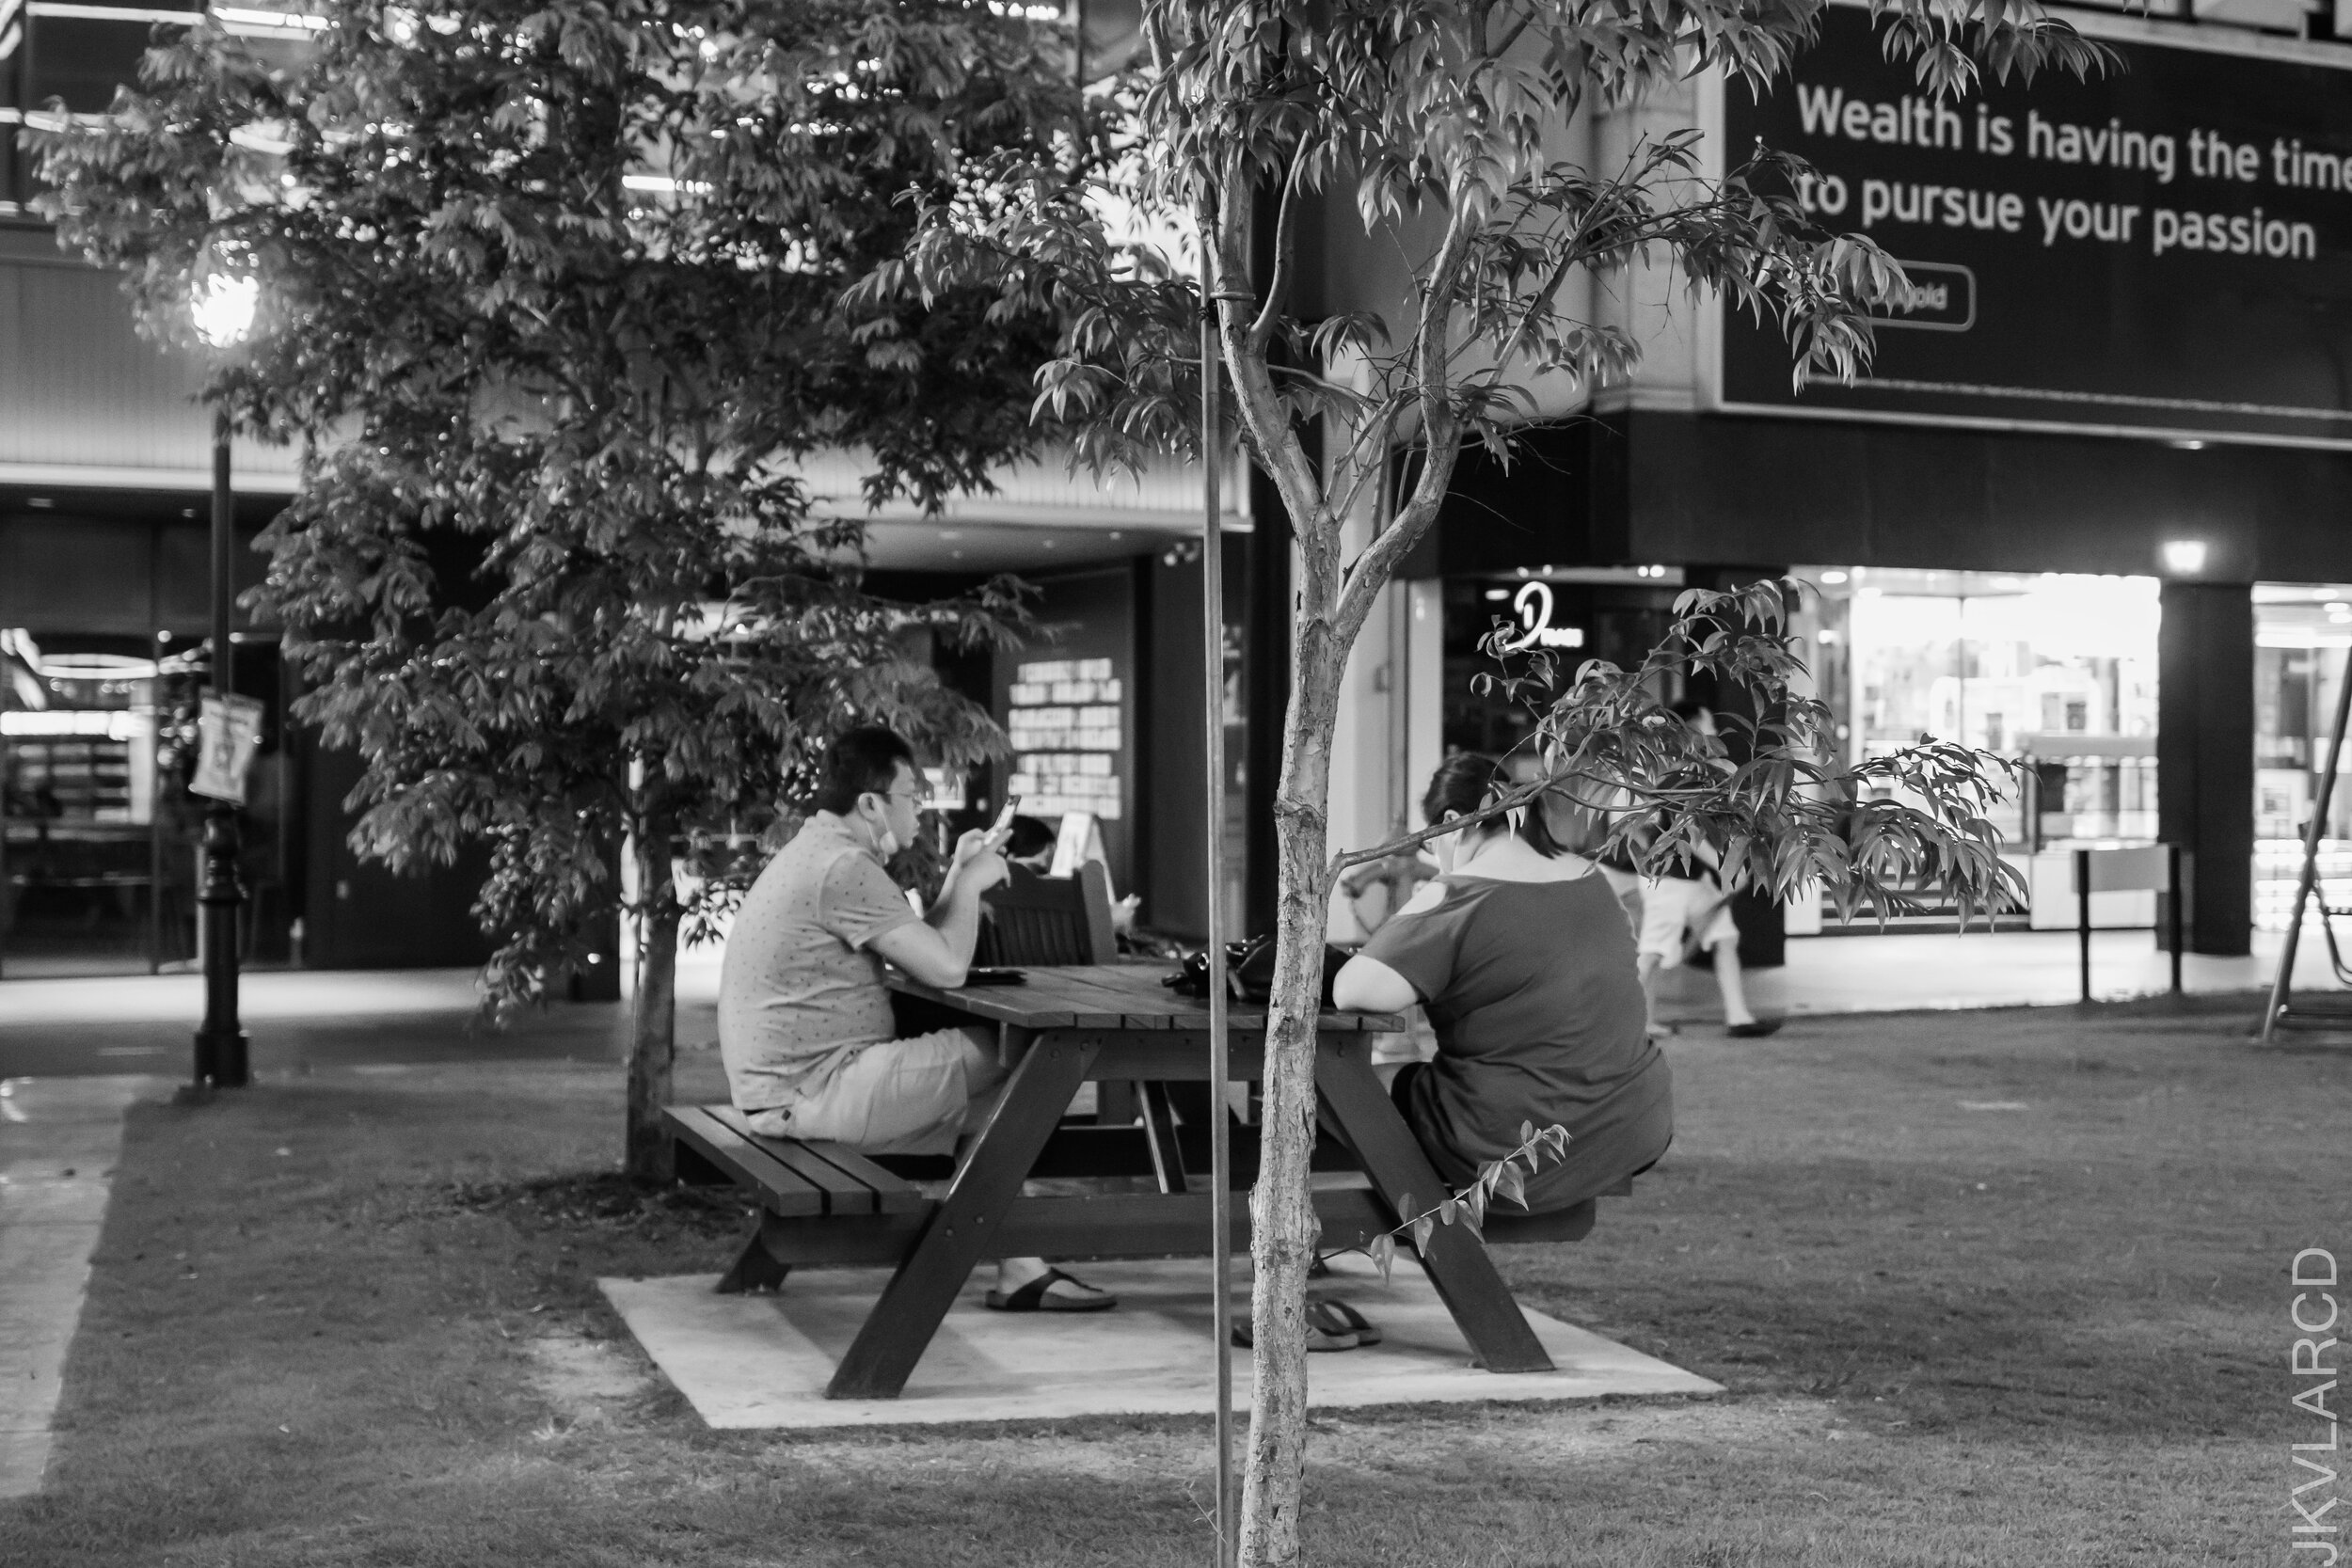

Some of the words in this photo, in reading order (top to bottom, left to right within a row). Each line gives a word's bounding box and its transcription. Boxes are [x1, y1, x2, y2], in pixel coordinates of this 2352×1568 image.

[1796, 82, 1963, 150] Wealth
[1977, 102, 2015, 156] is
[2027, 108, 2176, 184] having
[2188, 127, 2260, 182] the
[1798, 173, 1849, 215] to
[1861, 179, 2025, 233] pursue
[2036, 196, 2141, 247] your
[2153, 206, 2316, 260] passion
